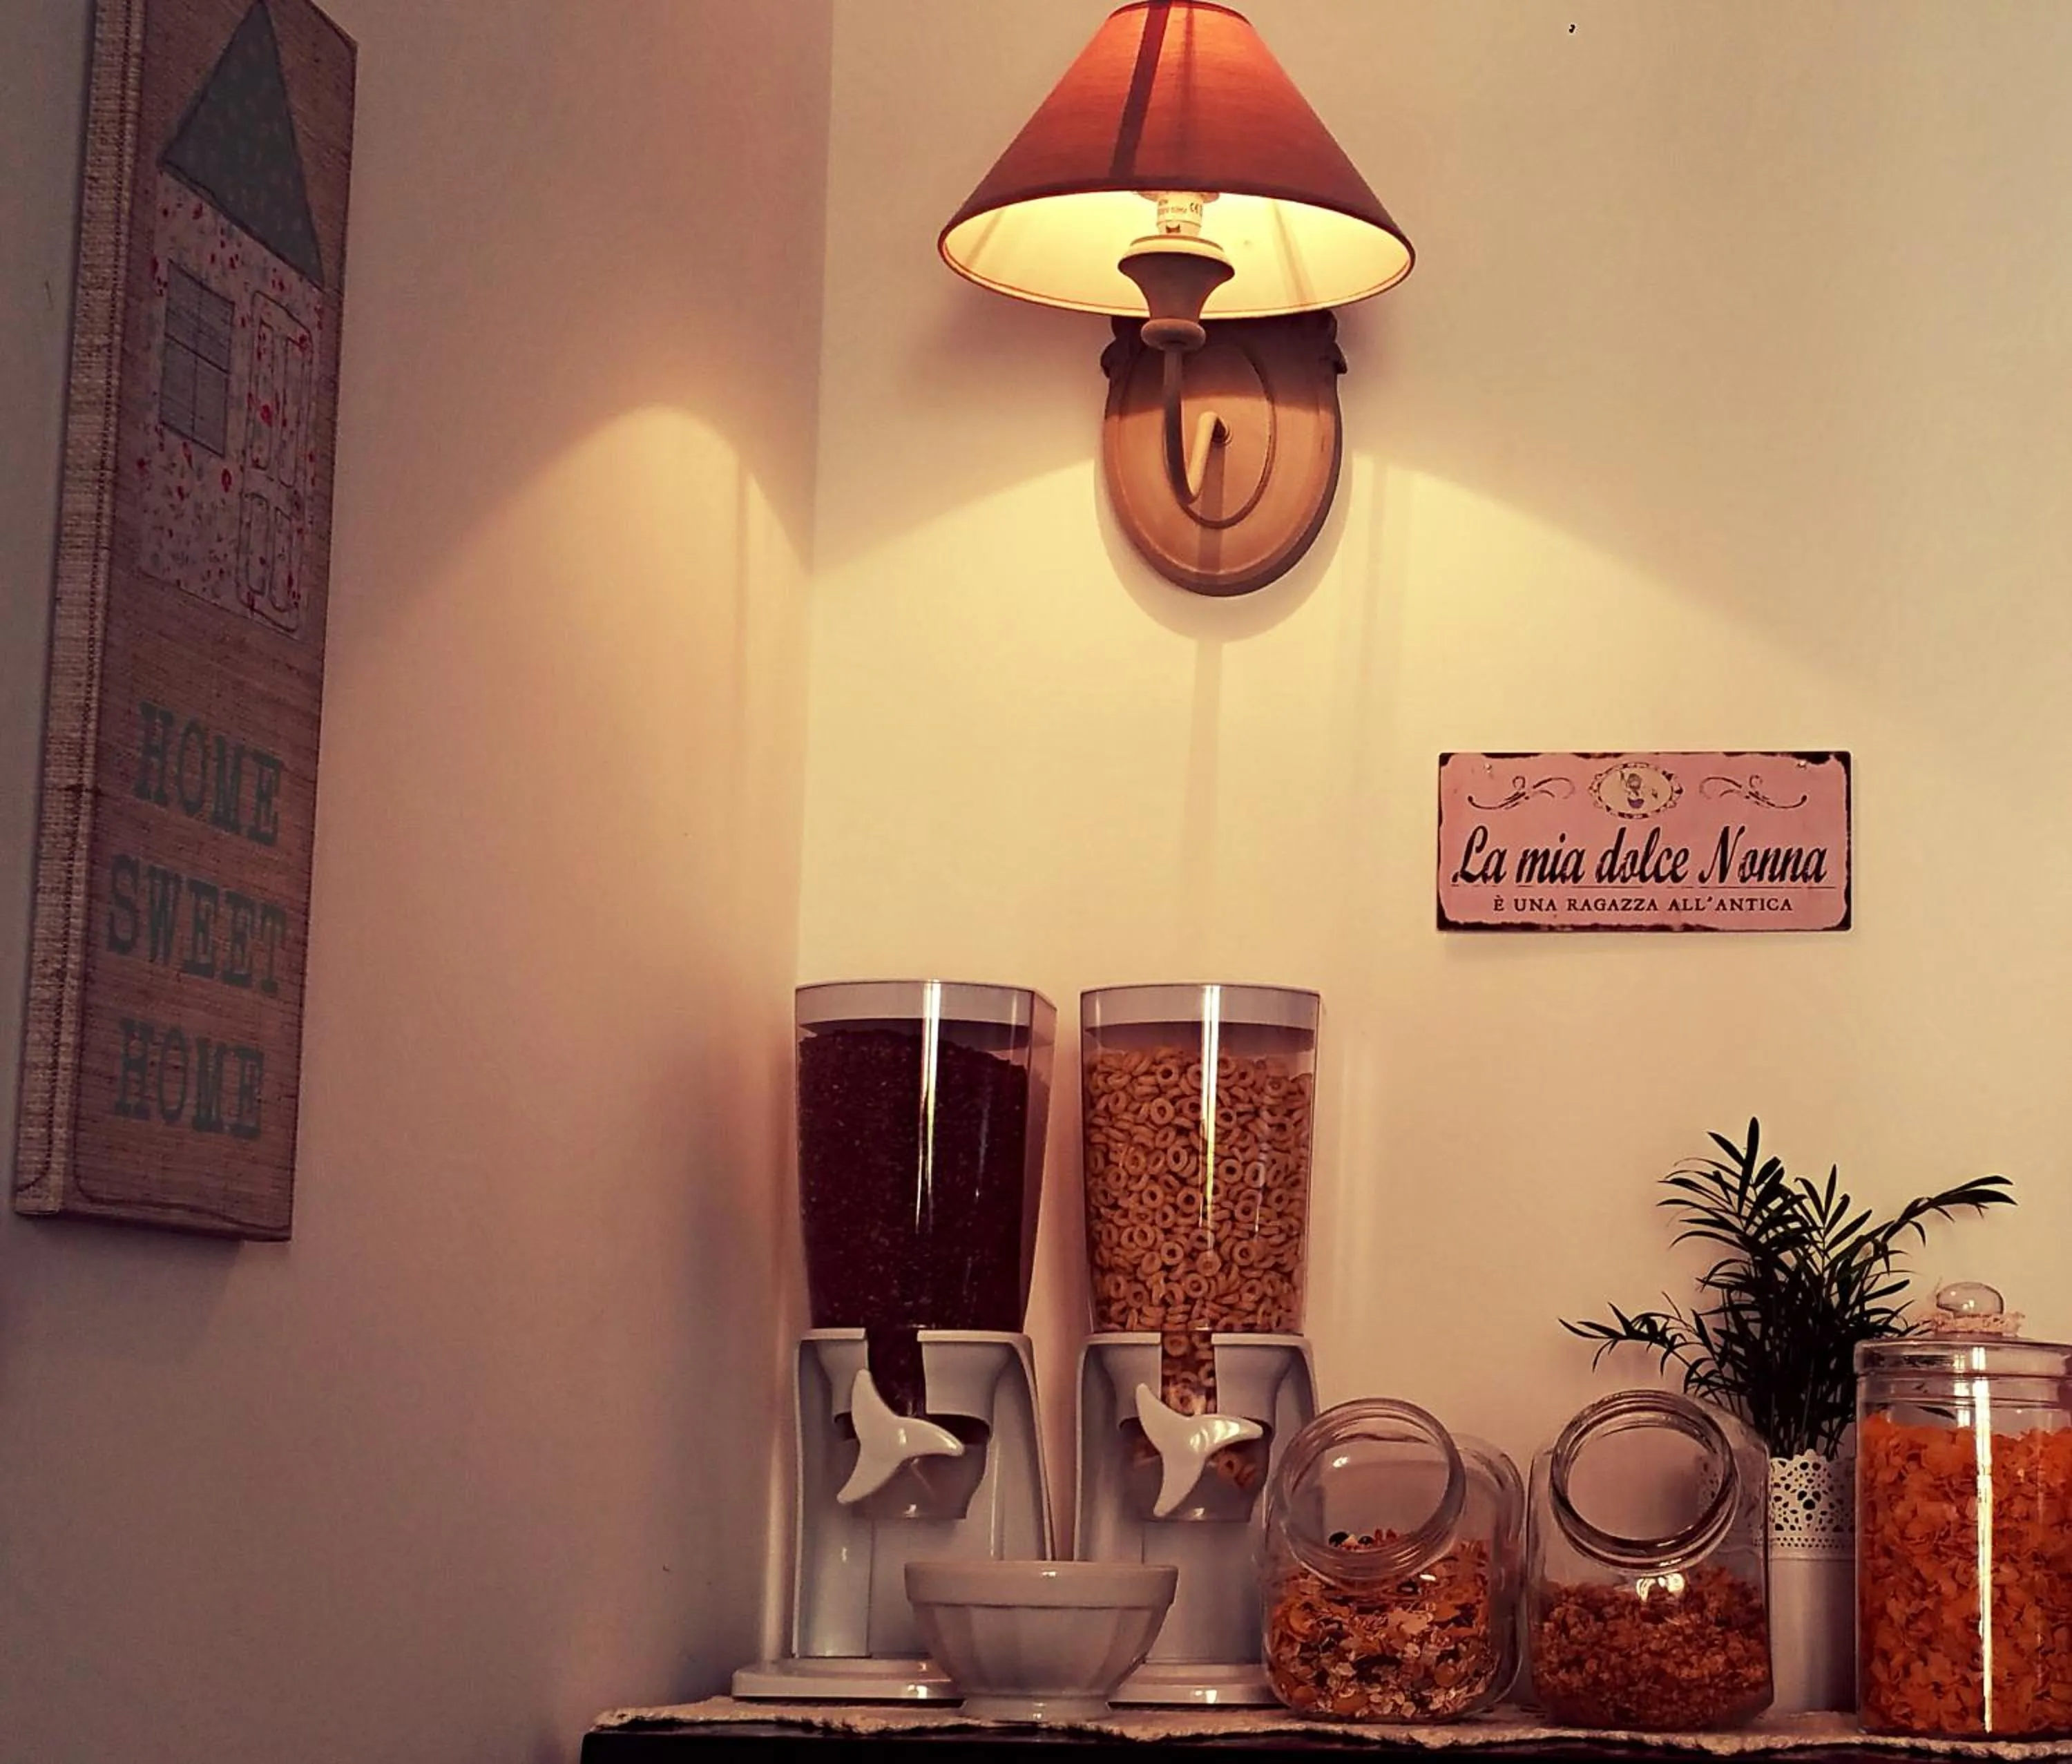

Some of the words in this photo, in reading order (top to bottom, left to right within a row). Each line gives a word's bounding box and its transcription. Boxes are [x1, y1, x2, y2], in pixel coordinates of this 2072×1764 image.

[135, 701, 282, 845] HOME
[1452, 826, 1507, 883] La
[1515, 833, 1585, 884] mia
[1595, 827, 1689, 883] dolce
[1698, 826, 1828, 884] Nonna
[1493, 895, 1504, 911] È
[1514, 897, 1557, 912] UNA
[1566, 897, 1658, 912] RAGAZZA
[1667, 896, 1793, 912] ALL'ANTICA
[108, 854, 287, 995] SWEET
[114, 1017, 265, 1139] HOME
